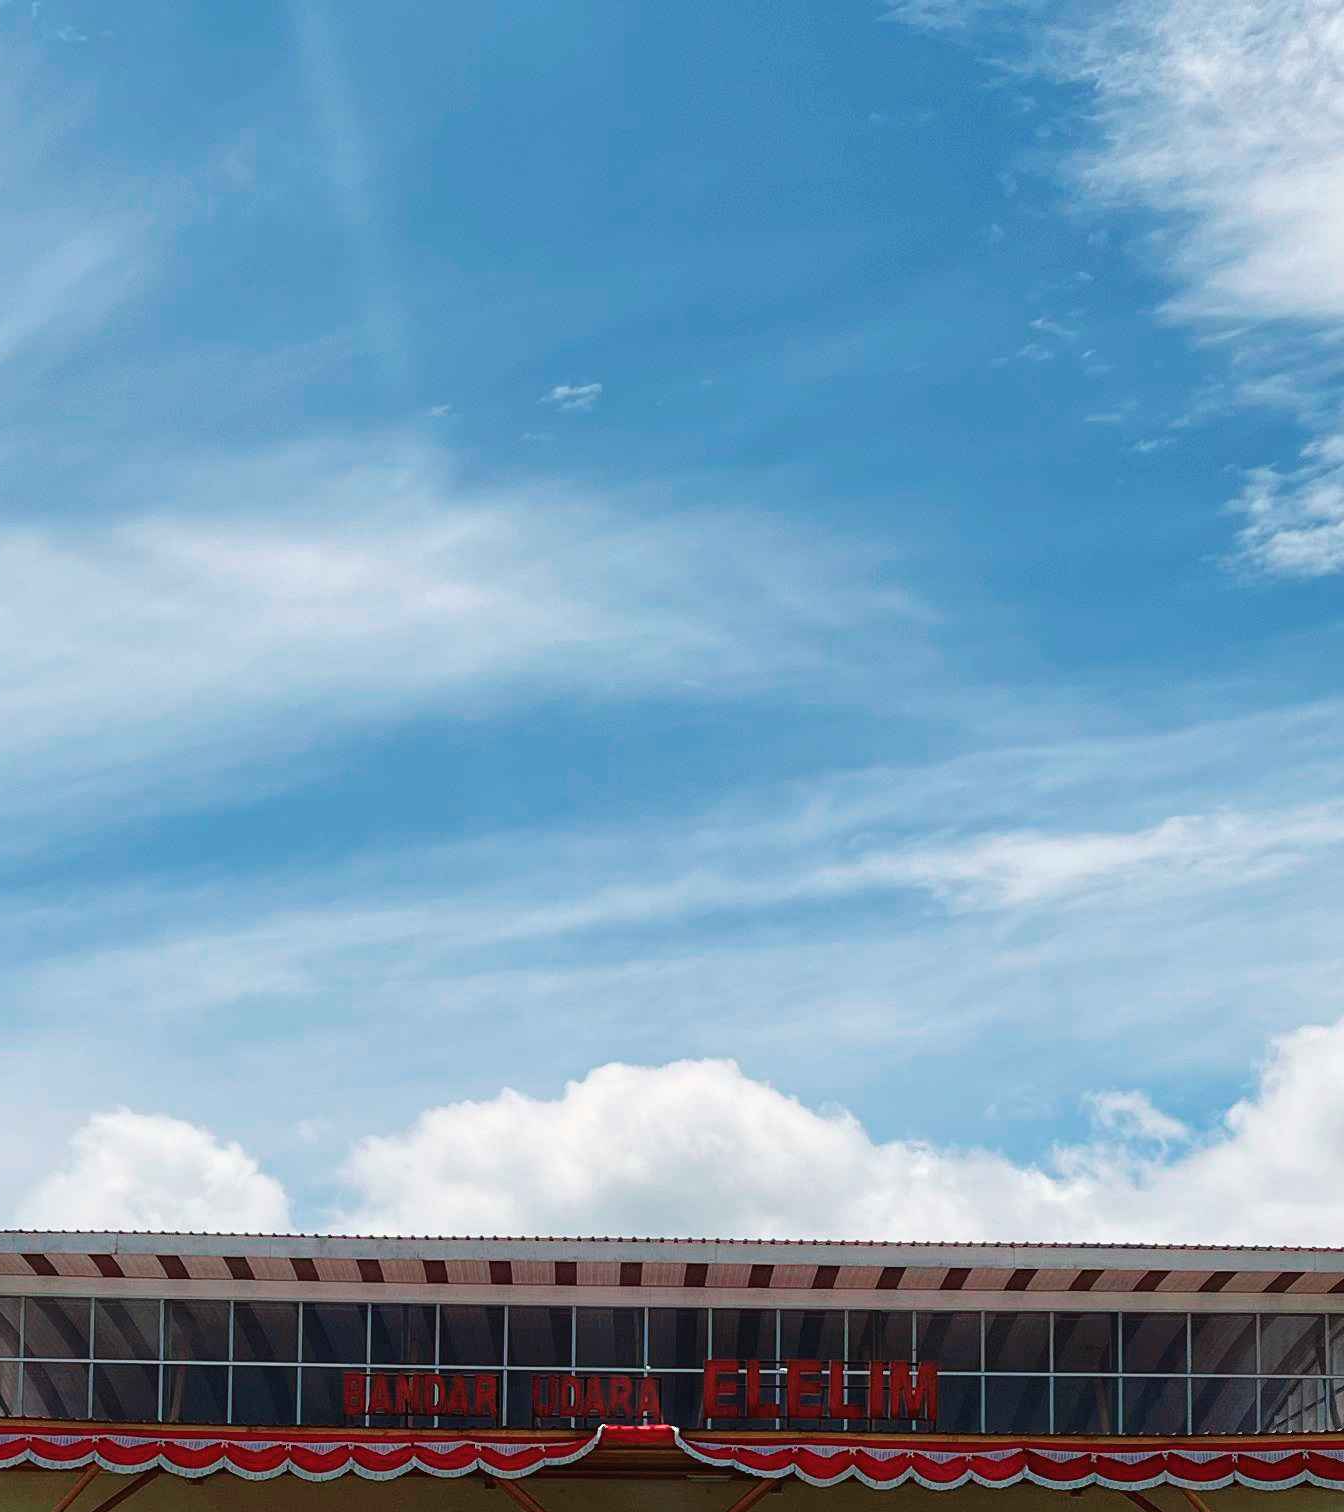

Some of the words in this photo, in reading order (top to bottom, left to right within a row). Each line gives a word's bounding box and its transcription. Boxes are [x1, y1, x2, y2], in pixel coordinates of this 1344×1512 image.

[343, 1372, 498, 1416] BANDAR
[532, 1375, 661, 1418] UDARA
[704, 1359, 939, 1420] ELELIM
